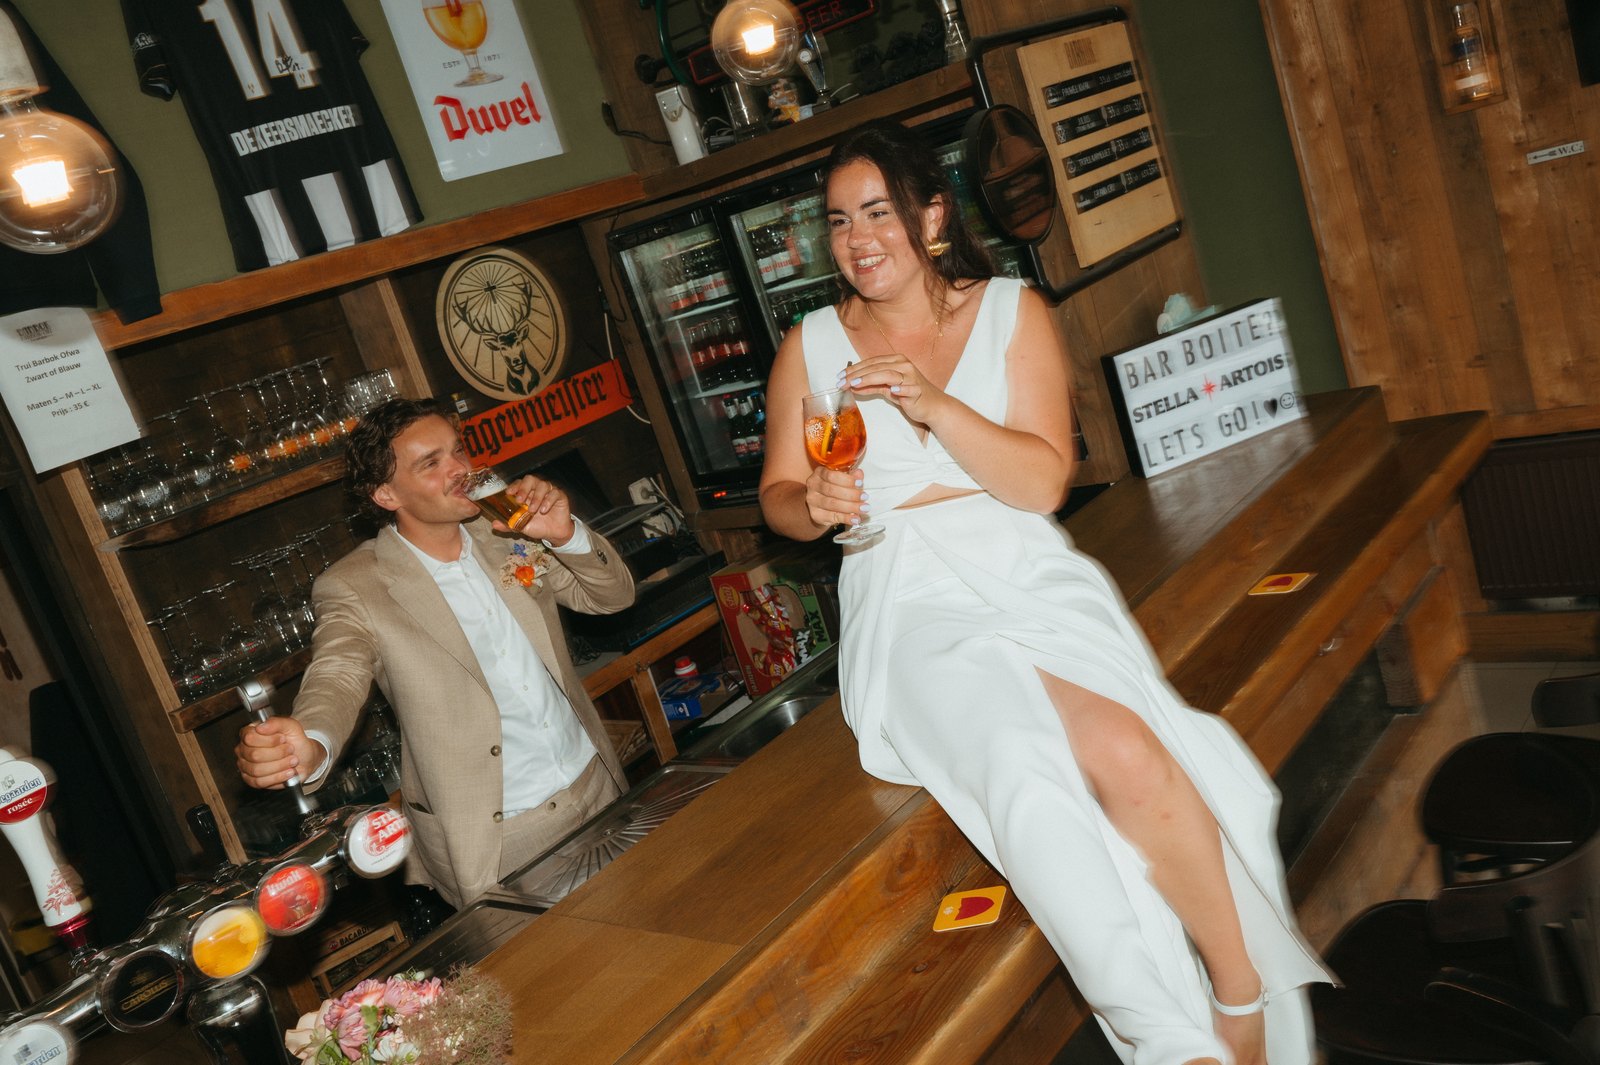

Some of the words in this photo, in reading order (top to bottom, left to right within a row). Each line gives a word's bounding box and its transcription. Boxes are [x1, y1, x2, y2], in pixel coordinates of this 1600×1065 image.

[198, 0, 316, 99] 14
[434, 81, 542, 142] Duvel
[15, 361, 32, 372] Trui
[32, 353, 59, 367] Barbok
[59, 348, 81, 360] Ofwa
[25, 371, 49, 384] Zwart
[49, 367, 58, 376] of
[58, 362, 81, 374] Blauw
[1123, 350, 1172, 390] BAR
[26, 398, 52, 412] Maten
[53, 395, 59, 404] S
[65, 391, 74, 399] M
[80, 387, 86, 395] L
[91, 383, 102, 391] XL
[1132, 387, 1200, 424] STELLA
[1219, 353, 1286, 391] ARTOIS
[72, 401, 83, 411] 35
[462, 371, 607, 458] ägermeister
[1143, 423, 1205, 469] LETS
[0, 777, 42, 805] egaarden
[7, 796, 33, 814] rosée
